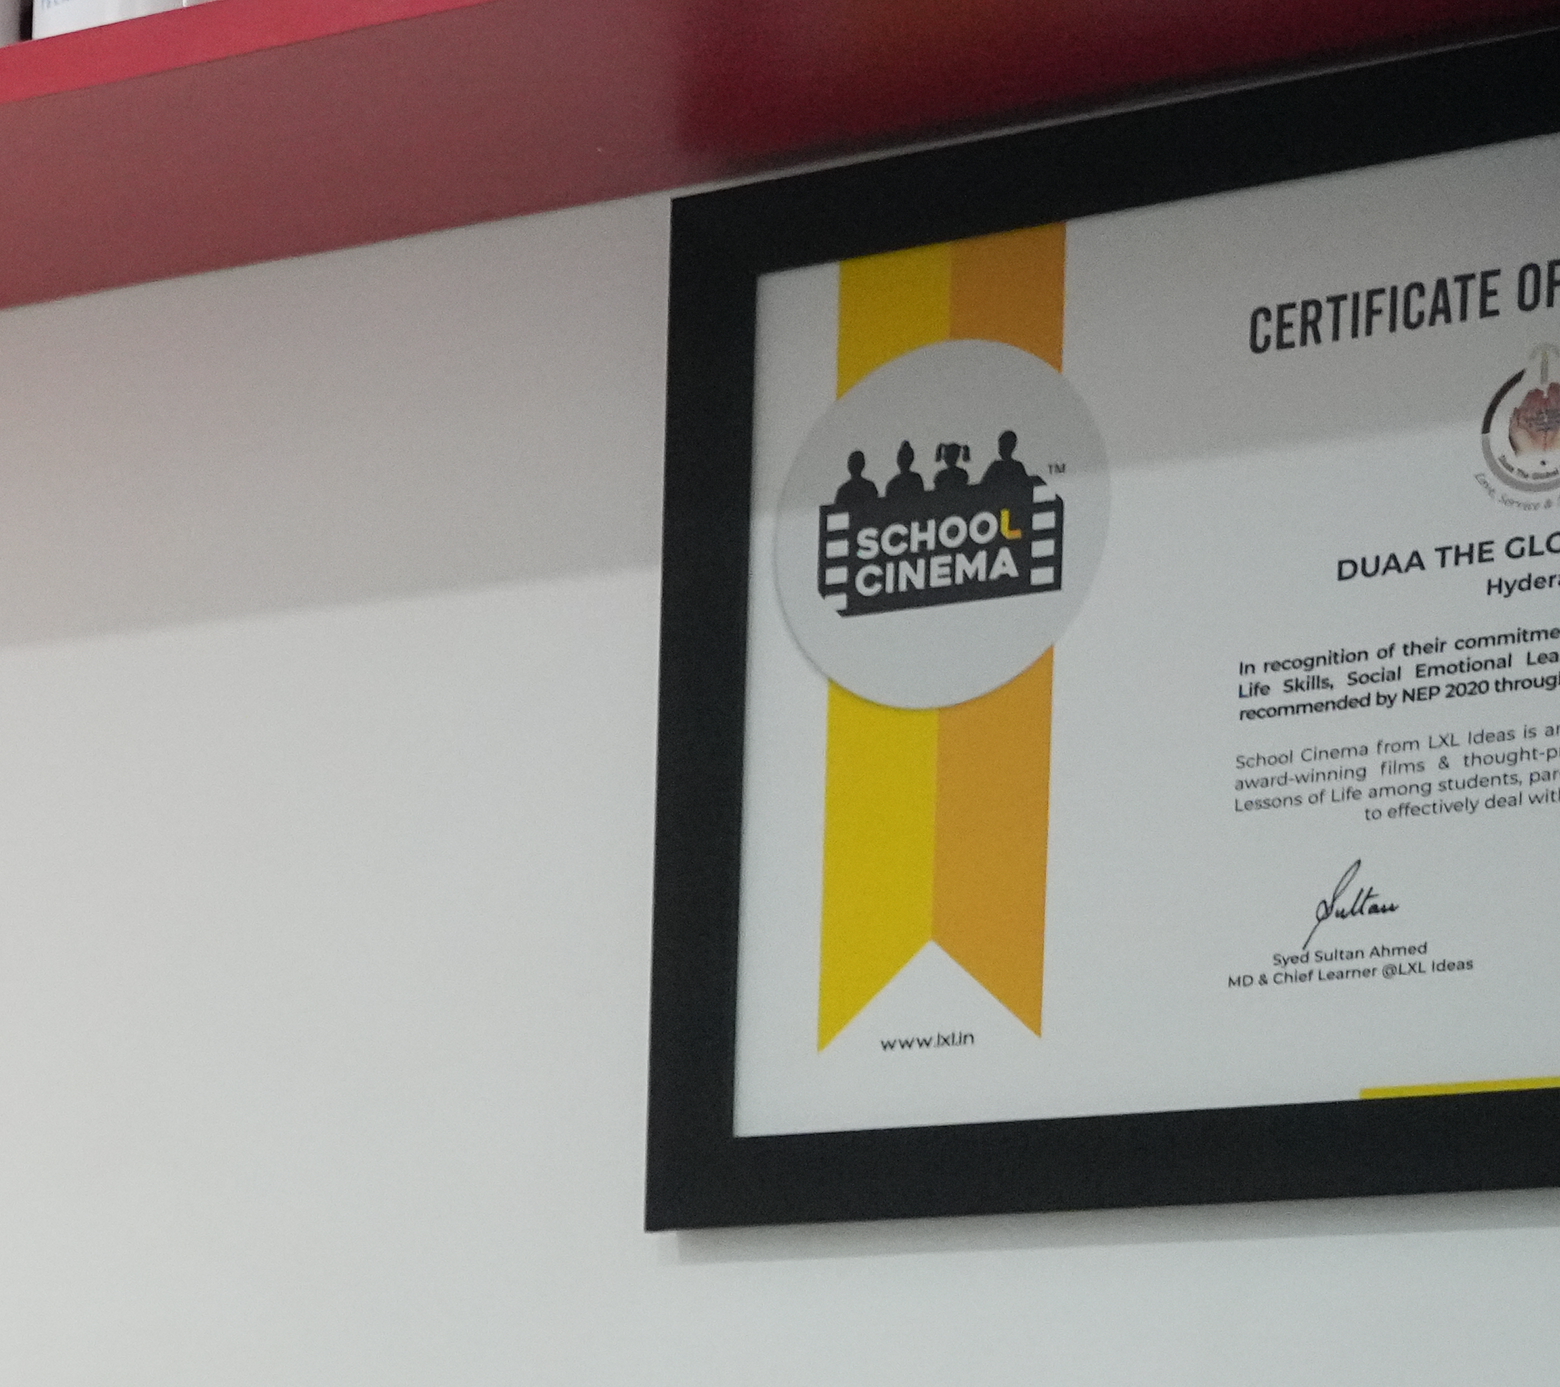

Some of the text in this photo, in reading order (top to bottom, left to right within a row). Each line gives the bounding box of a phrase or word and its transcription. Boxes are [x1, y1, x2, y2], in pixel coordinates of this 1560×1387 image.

[1248, 268, 1501, 355] CERTIFICATE
[1049, 462, 1065, 475] TM
[856, 506, 1022, 561] SCHOOL
[854, 545, 1019, 598] CINEMA
[1337, 548, 1426, 581] DUAA
[1435, 540, 1494, 569] THE
[1486, 569, 1560, 599] Hyder
[1238, 681, 1270, 699] Life
[1282, 673, 1334, 696] Skills,
[1347, 666, 1401, 686] Social
[1415, 652, 1512, 679] Emotional
[1239, 660, 1255, 675] In
[1263, 645, 1368, 675] recognition
[1376, 643, 1395, 659] of
[1402, 636, 1446, 657] their
[1239, 671, 1560, 721] recommended by NEP 2020 throug
[1236, 750, 1293, 769] School
[1301, 742, 1368, 763] Cinema
[1376, 736, 1419, 755] from
[1428, 732, 1459, 749] LXL
[1468, 726, 1515, 745] Ideas
[1522, 724, 1537, 740] is
[1234, 763, 1366, 794] award-winning
[1380, 758, 1424, 776] films
[1437, 756, 1449, 770] &
[1235, 793, 1301, 813] Lessons
[1308, 789, 1327, 805] of
[1331, 786, 1362, 803] Life
[1368, 781, 1431, 803] among
[1437, 770, 1522, 795] students,
[1364, 807, 1382, 821] to
[1387, 796, 1478, 822] effectively
[1484, 792, 1522, 810] deal
[1227, 956, 1473, 988] MD & Chief Learner @LXL Ideas
[1272, 941, 1427, 968] Syed Sultan Ahmed
[881, 1029, 975, 1052] www.lxl.in
